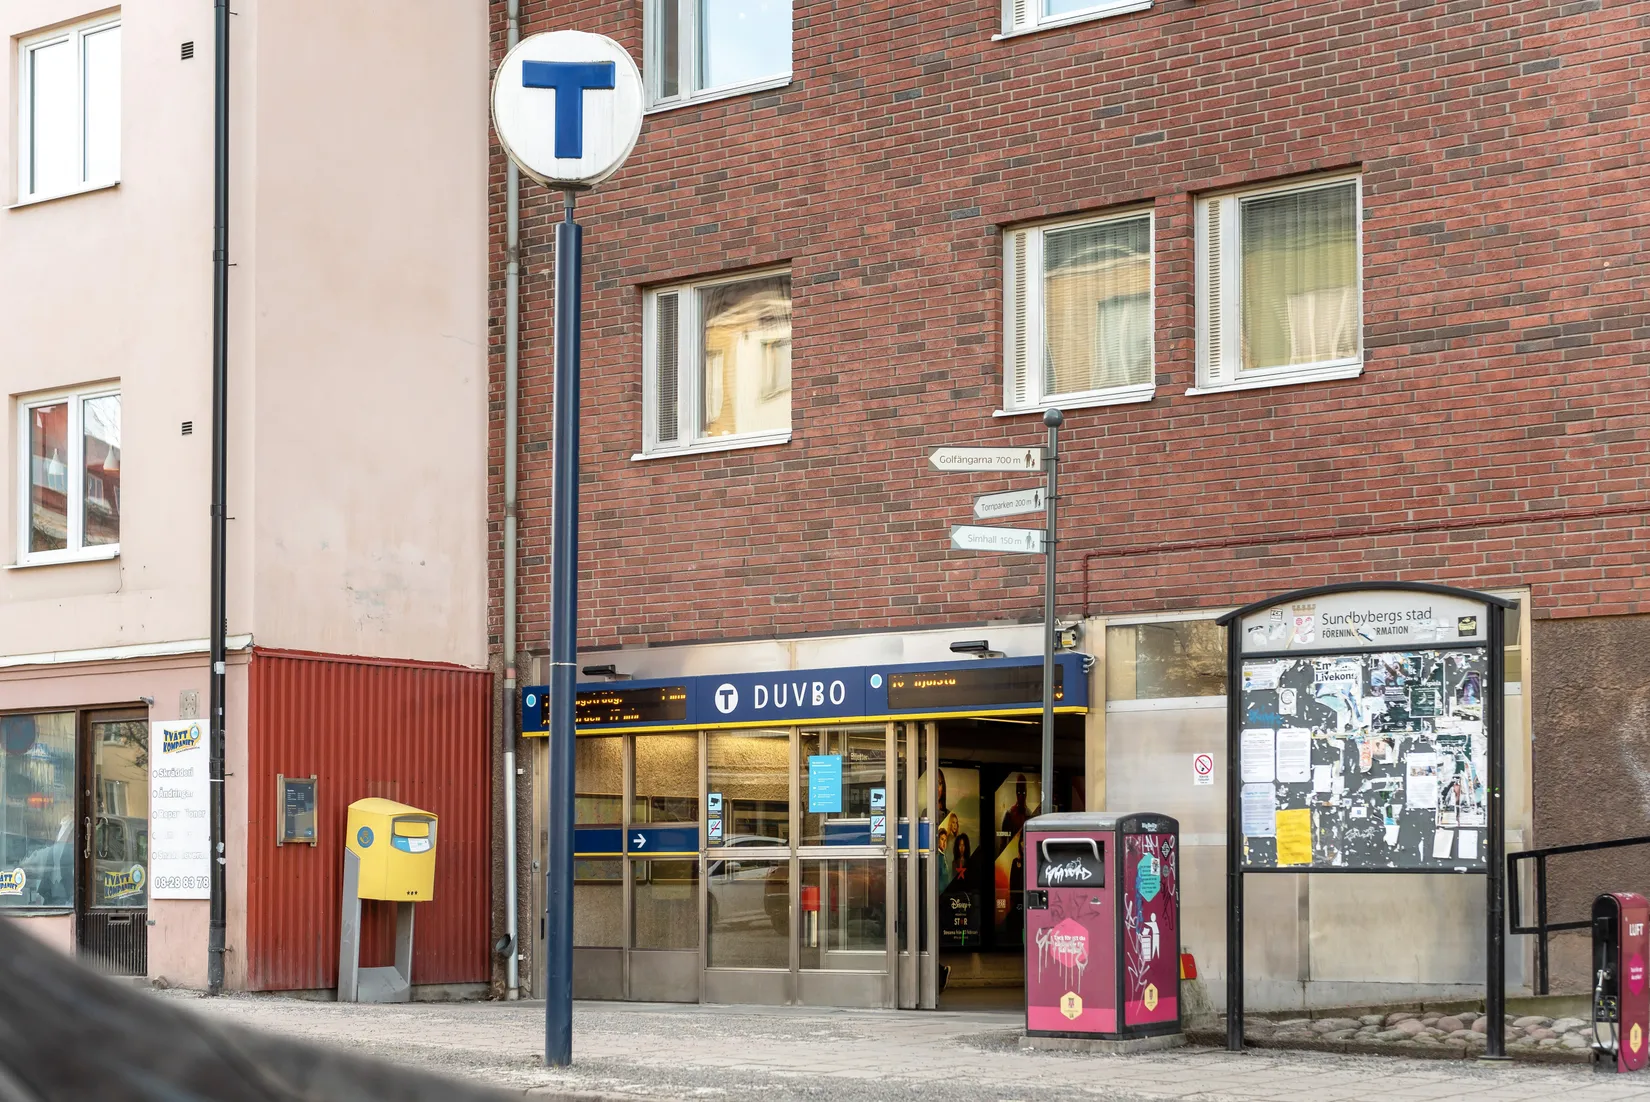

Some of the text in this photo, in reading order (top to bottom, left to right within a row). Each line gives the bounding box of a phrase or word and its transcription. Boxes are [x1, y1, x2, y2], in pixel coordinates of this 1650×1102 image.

[522, 60, 615, 158] T
[939, 455, 993, 466] Golfängarna
[996, 456, 1011, 464] 700
[1015, 499, 1026, 507] 200
[967, 534, 997, 544] Simhall
[1000, 537, 1013, 545] 150
[1322, 606, 1432, 627] Sundbybergs stad
[754, 680, 846, 709] DUVBO
[163, 729, 188, 742] TVÄTT
[163, 740, 195, 753] KOMPANIET
[158, 767, 195, 778] Skrädderi
[158, 786, 194, 799] Ändringar
[105, 873, 130, 886] TVÄTT
[182, 876, 195, 889] 83
[197, 876, 210, 889] 78
[104, 883, 138, 897] KOMPANIET
[1629, 923, 1644, 936] LUFT
